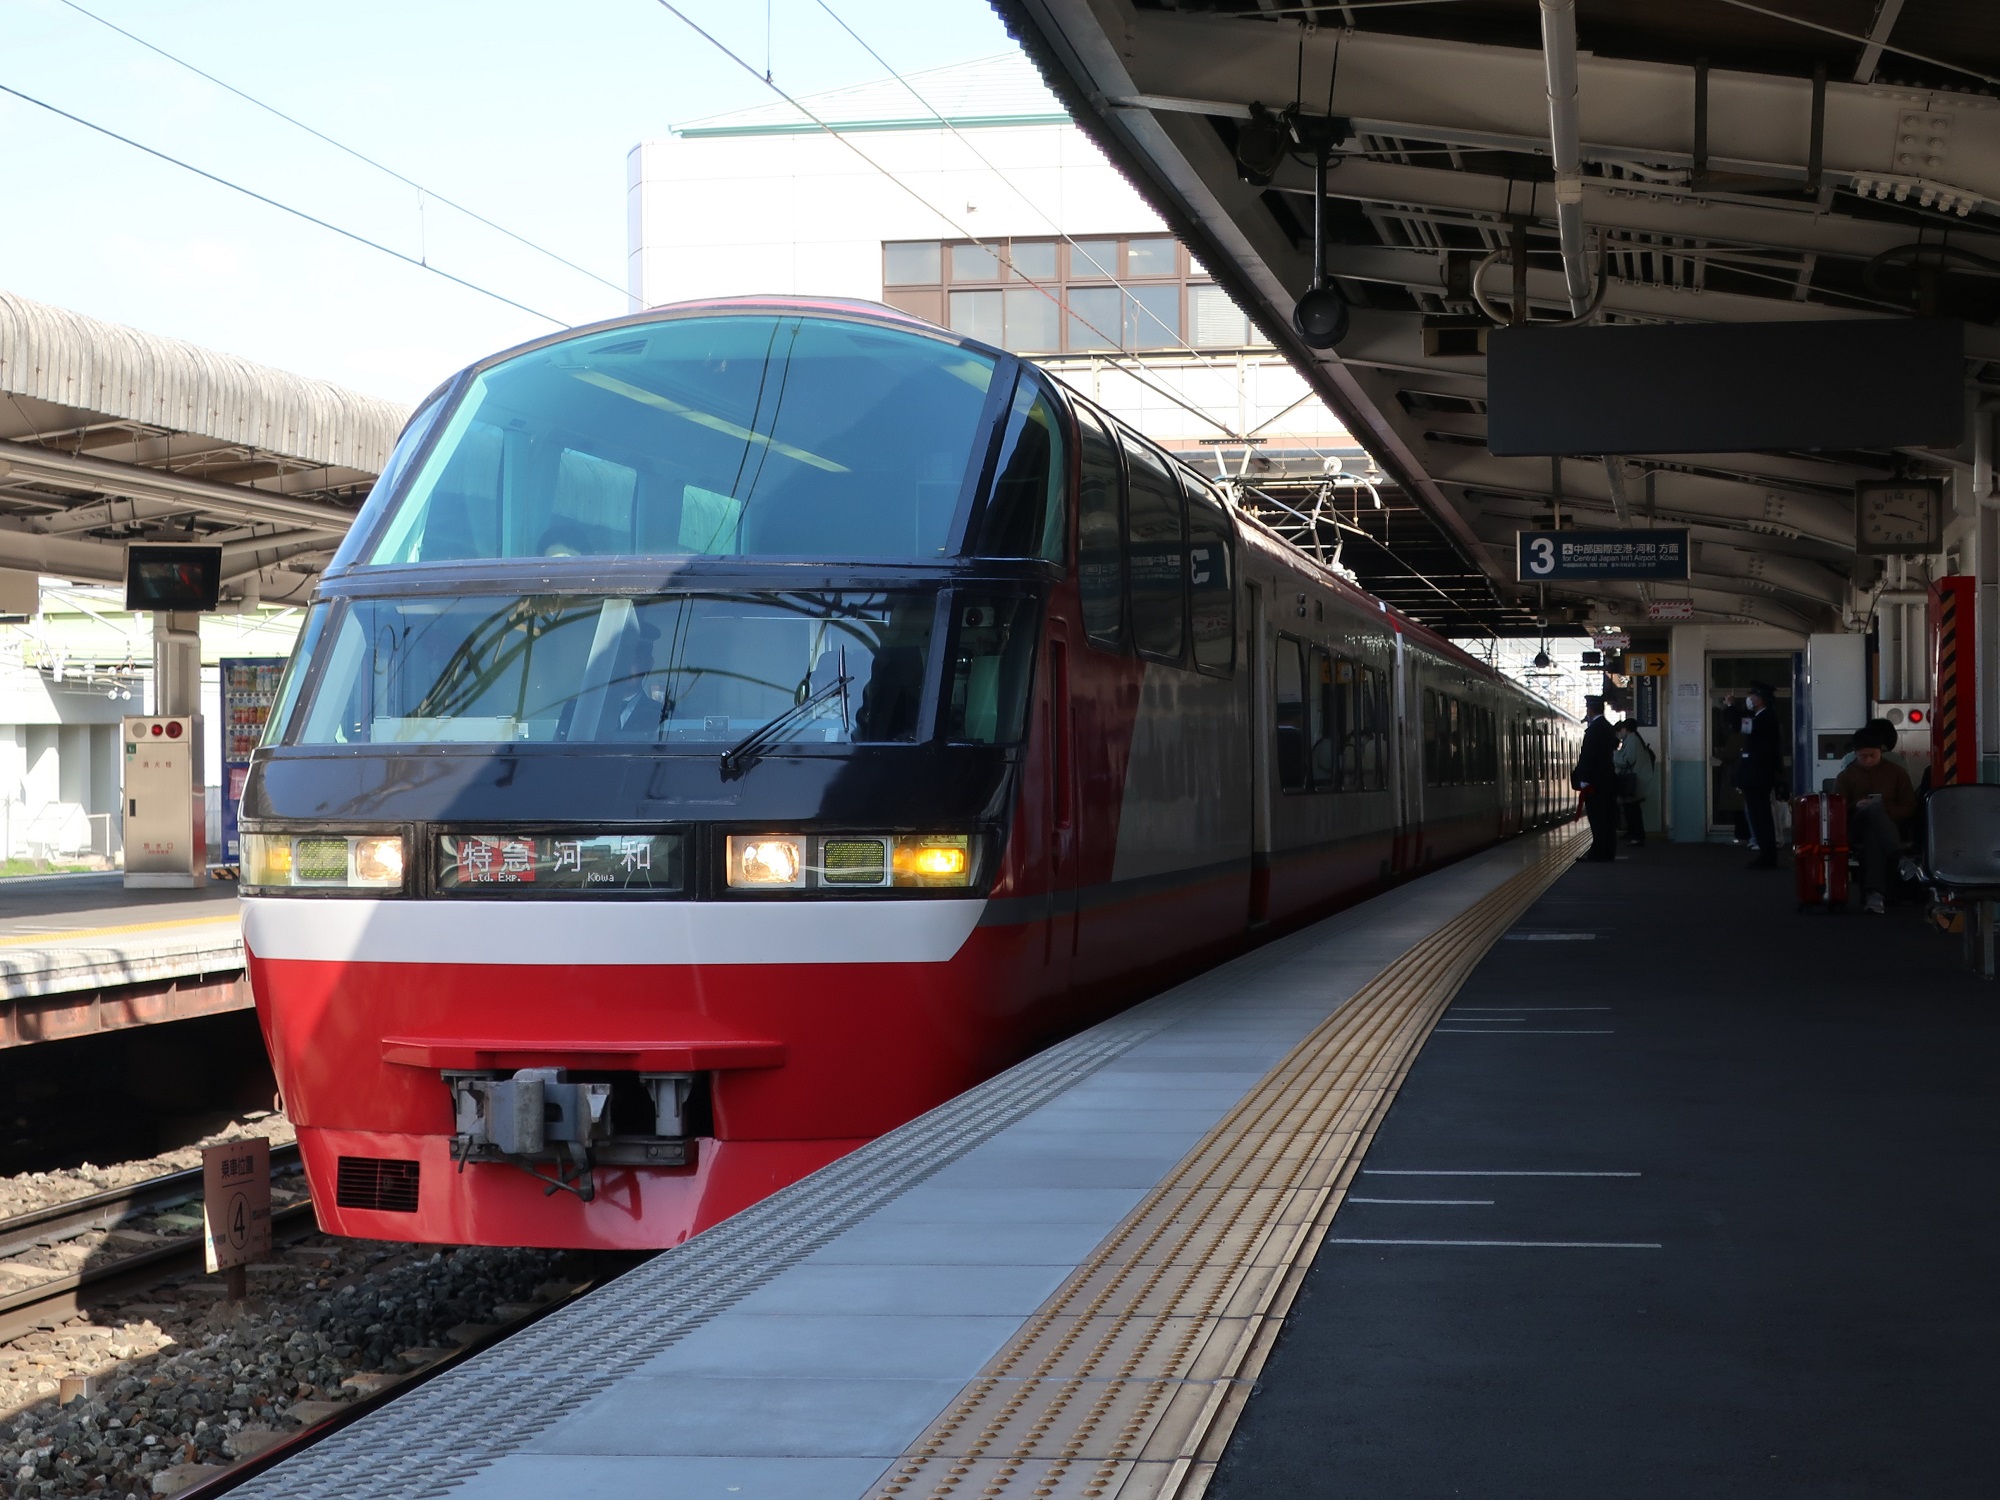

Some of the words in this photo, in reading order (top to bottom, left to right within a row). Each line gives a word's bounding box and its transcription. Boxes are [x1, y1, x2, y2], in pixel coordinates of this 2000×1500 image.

[1658, 543, 1679, 554] 方面
[1530, 538, 1555, 574] 3
[1562, 554, 1572, 562] for
[1573, 554, 1598, 562] Central
[1598, 554, 1620, 564] Japan
[1643, 675, 1651, 686] 3
[462, 841, 531, 873] 特急
[470, 872, 494, 883] Ltd.
[498, 872, 522, 883] Exp.
[233, 1201, 246, 1241] 4
